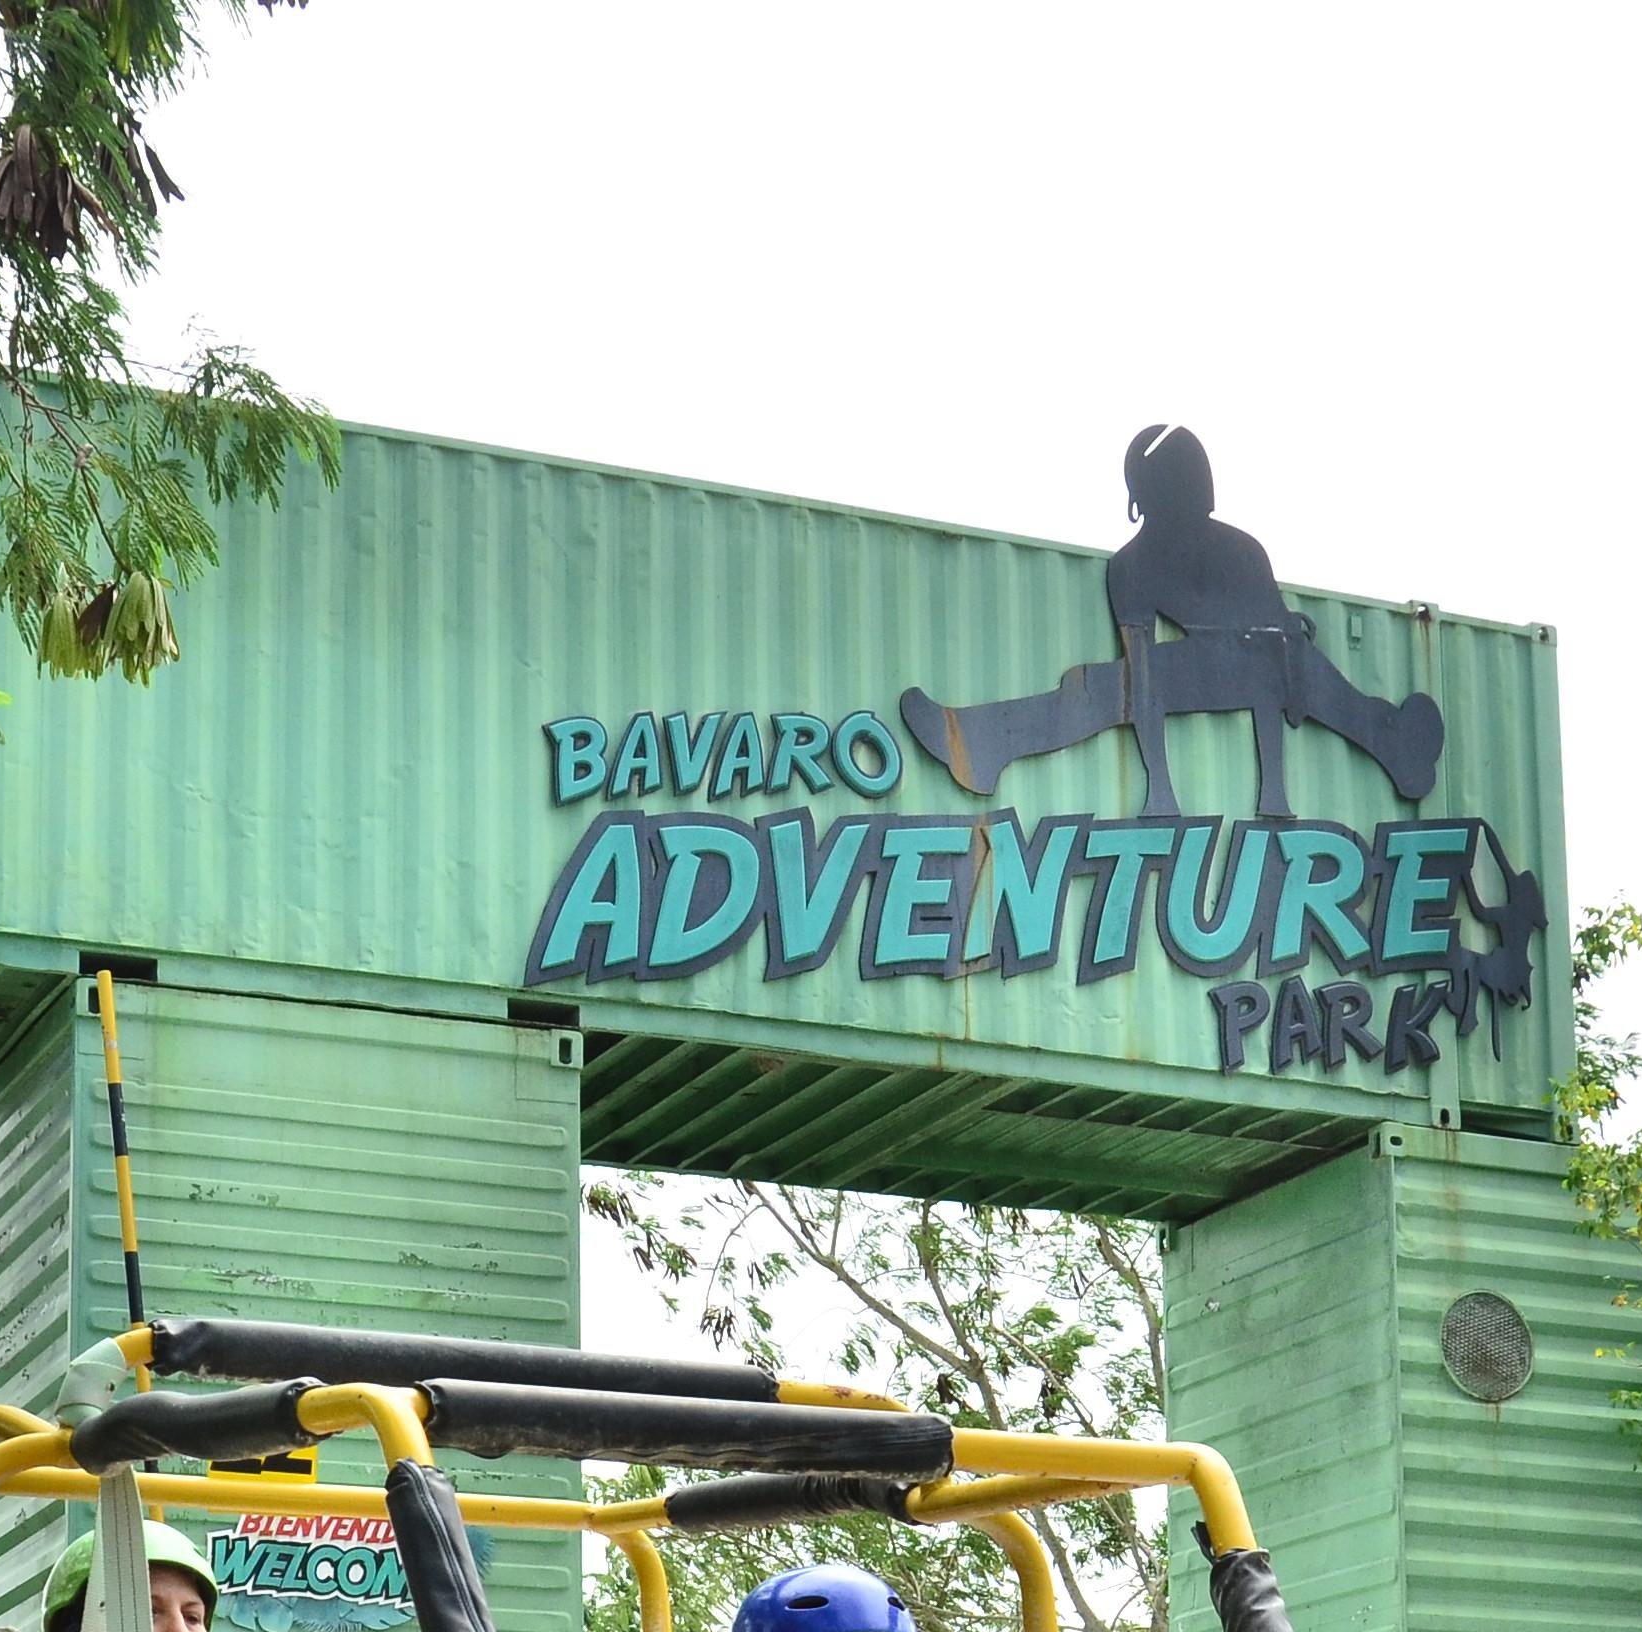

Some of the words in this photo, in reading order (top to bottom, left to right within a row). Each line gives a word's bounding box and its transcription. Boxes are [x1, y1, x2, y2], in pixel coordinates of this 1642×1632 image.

[542, 710, 903, 806] BAVARO
[527, 808, 1483, 984] ADVENTURE
[1208, 974, 1450, 1076] PARK
[212, 1536, 411, 1599] WELCOM
